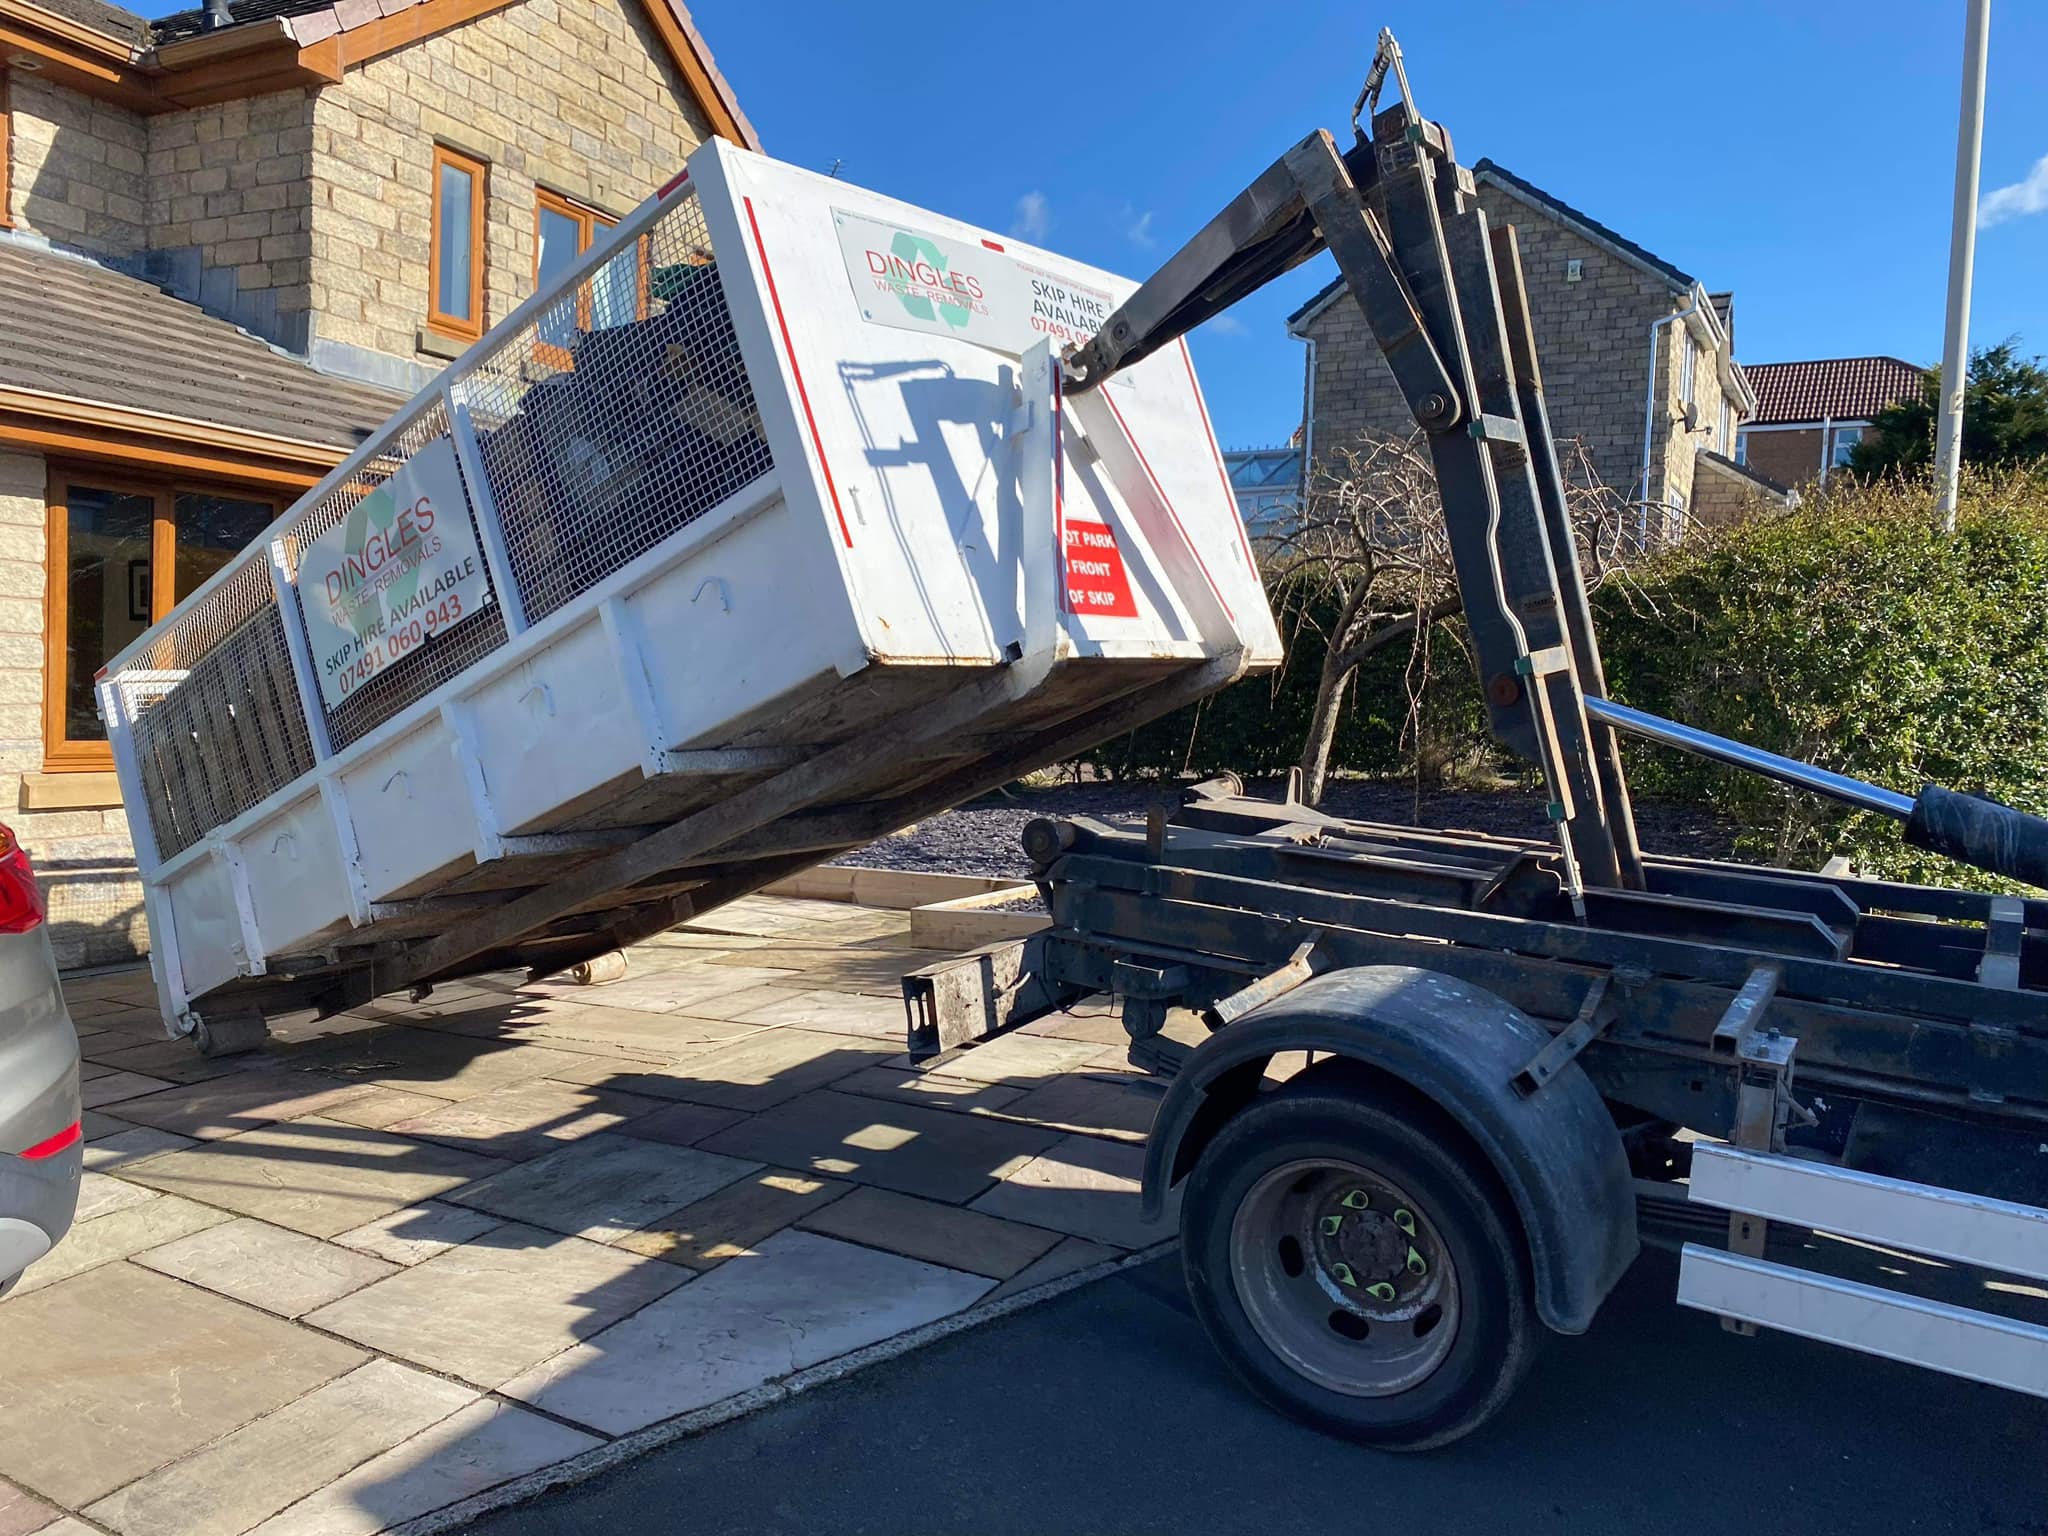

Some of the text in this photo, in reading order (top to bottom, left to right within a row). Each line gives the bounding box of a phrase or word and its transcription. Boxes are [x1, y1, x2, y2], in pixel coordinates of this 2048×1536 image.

[865, 250, 983, 299] DINGLES
[873, 279, 989, 316] WASTE REMOVALS
[1031, 280, 1066, 304] SKIP
[1070, 293, 1105, 319] HIRE
[1031, 316, 1073, 341] 07491
[325, 496, 435, 606] DINGLES
[1065, 530, 1116, 548] OT PARK
[332, 536, 442, 627] WASTE REMOVALS
[1071, 559, 1111, 577] FRONT
[325, 556, 476, 676] SKIP HIRE AVAILABLE
[1068, 589, 1116, 606] OF SKIP
[339, 594, 464, 695] 07491 060 943
